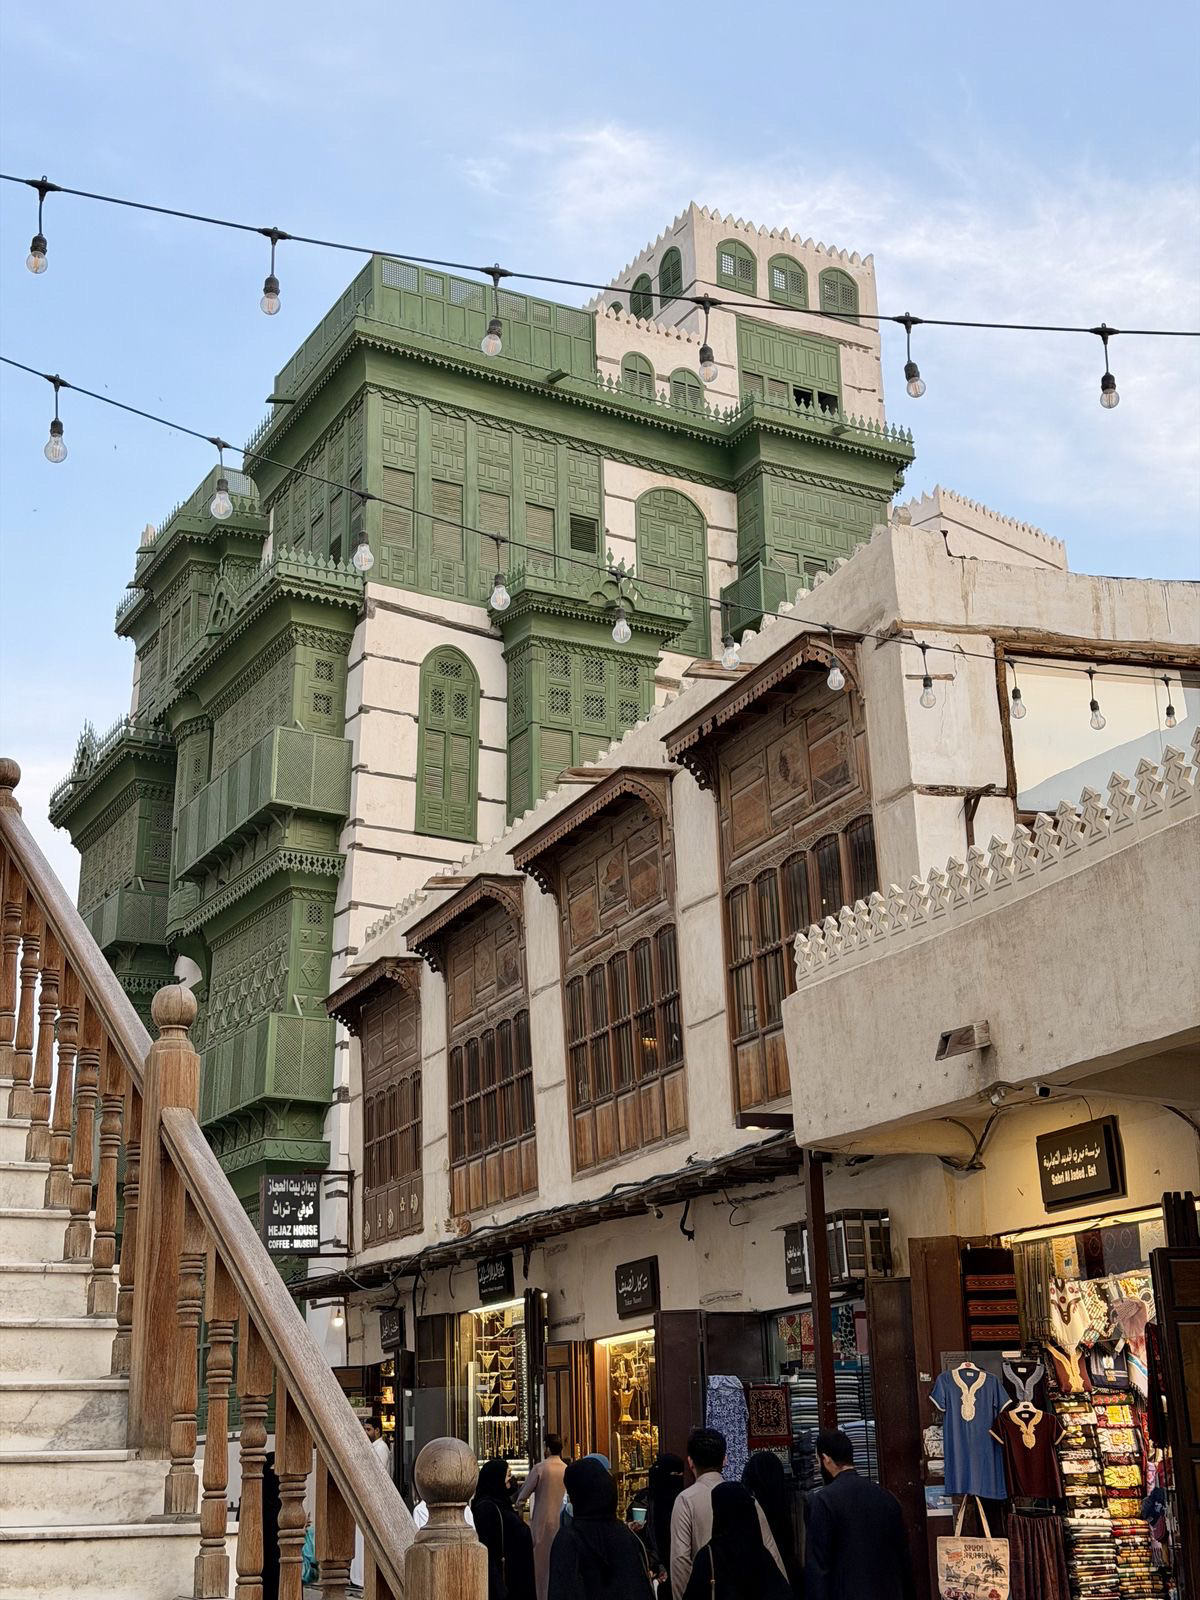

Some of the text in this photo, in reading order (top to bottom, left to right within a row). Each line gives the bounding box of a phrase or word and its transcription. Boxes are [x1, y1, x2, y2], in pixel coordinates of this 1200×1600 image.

[268, 1179, 317, 1196] ديوان بيت الحجاز
[272, 1200, 291, 1218] تراث
[297, 1200, 314, 1221] كوفي
[268, 1225, 318, 1236] HEJAZ HOUSE
[268, 1239, 290, 1249] COFFEE
[293, 1239, 319, 1249] MUSEUM
